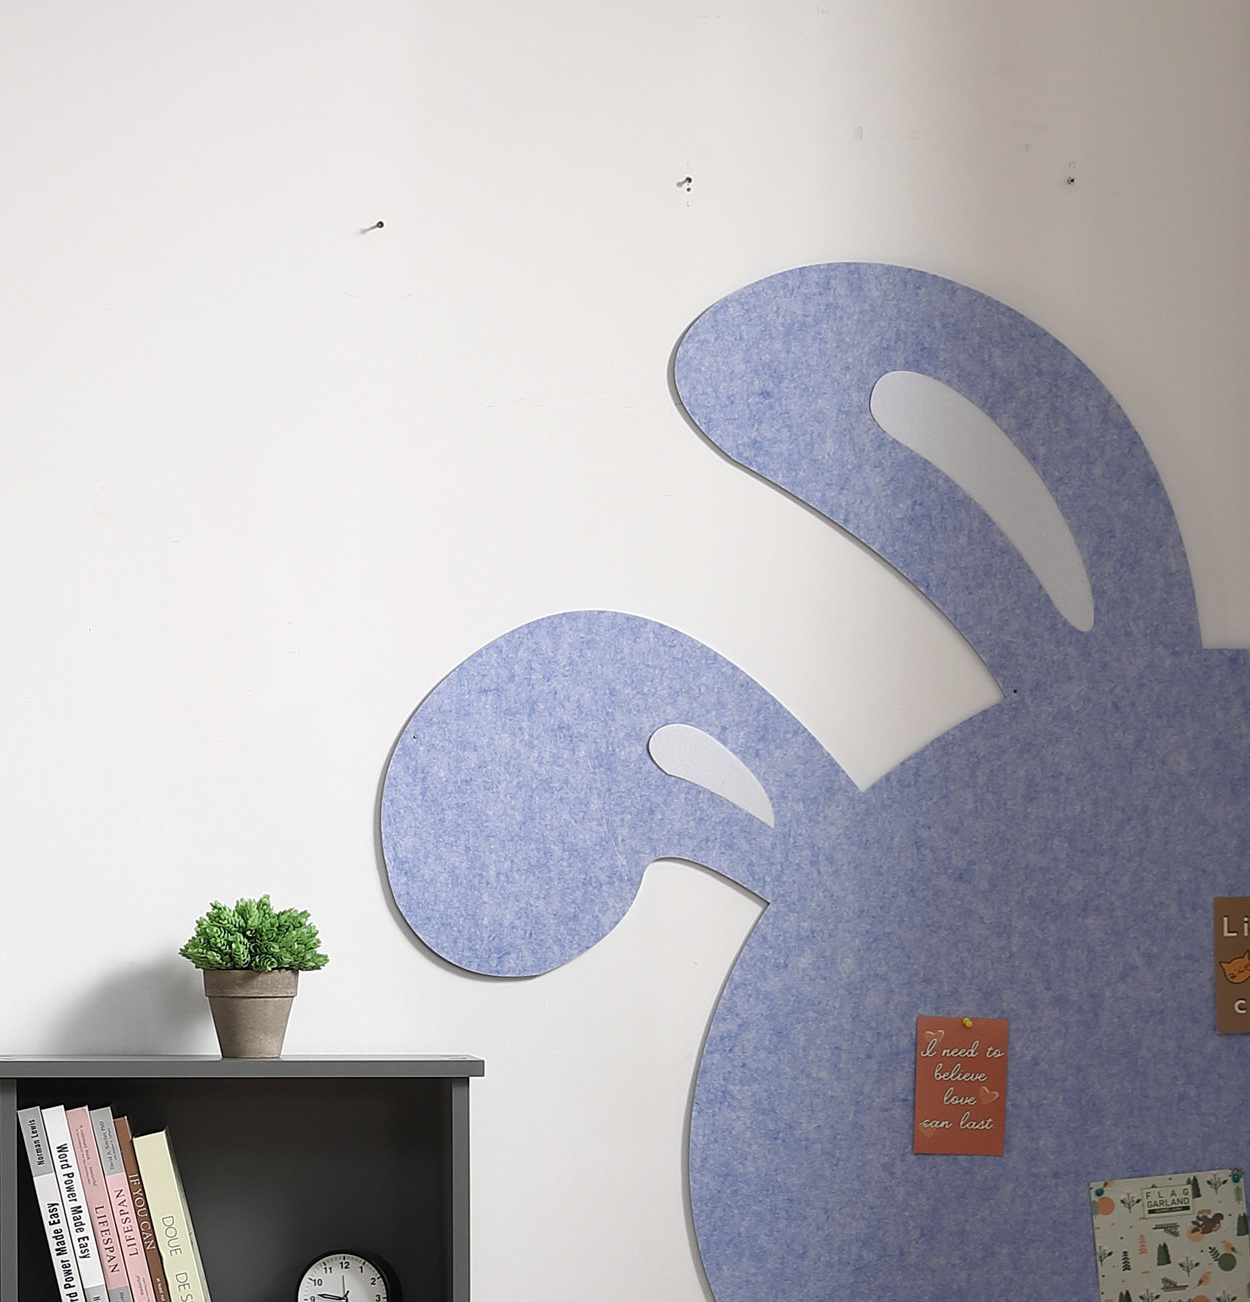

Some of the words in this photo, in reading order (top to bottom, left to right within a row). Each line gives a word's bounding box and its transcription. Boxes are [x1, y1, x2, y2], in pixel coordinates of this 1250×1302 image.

[942, 1040, 979, 1057] need
[986, 1047, 1004, 1058] to
[934, 1063, 987, 1081] believe
[943, 1087, 976, 1105] love
[28, 1119, 39, 1138] Lewis
[920, 1119, 952, 1128] can
[960, 1112, 993, 1129] last
[34, 1139, 45, 1165] Norman
[56, 1143, 73, 1170] Word
[62, 1172, 77, 1202] Power
[128, 1172, 141, 1187] IF
[47, 1203, 61, 1226] Easy
[131, 1186, 148, 1219] YOU
[1147, 1198, 1189, 1208] GARLAND
[70, 1205, 86, 1233] Made
[114, 1189, 139, 1256] LIFESPAN
[52, 1228, 68, 1256] Made
[77, 1235, 91, 1259] Easy
[95, 1205, 120, 1273] LIFESPAN
[140, 1221, 156, 1250] CAN
[161, 1215, 182, 1257] DOUE
[175, 1272, 191, 1292] DE
[60, 1259, 76, 1290] Power
